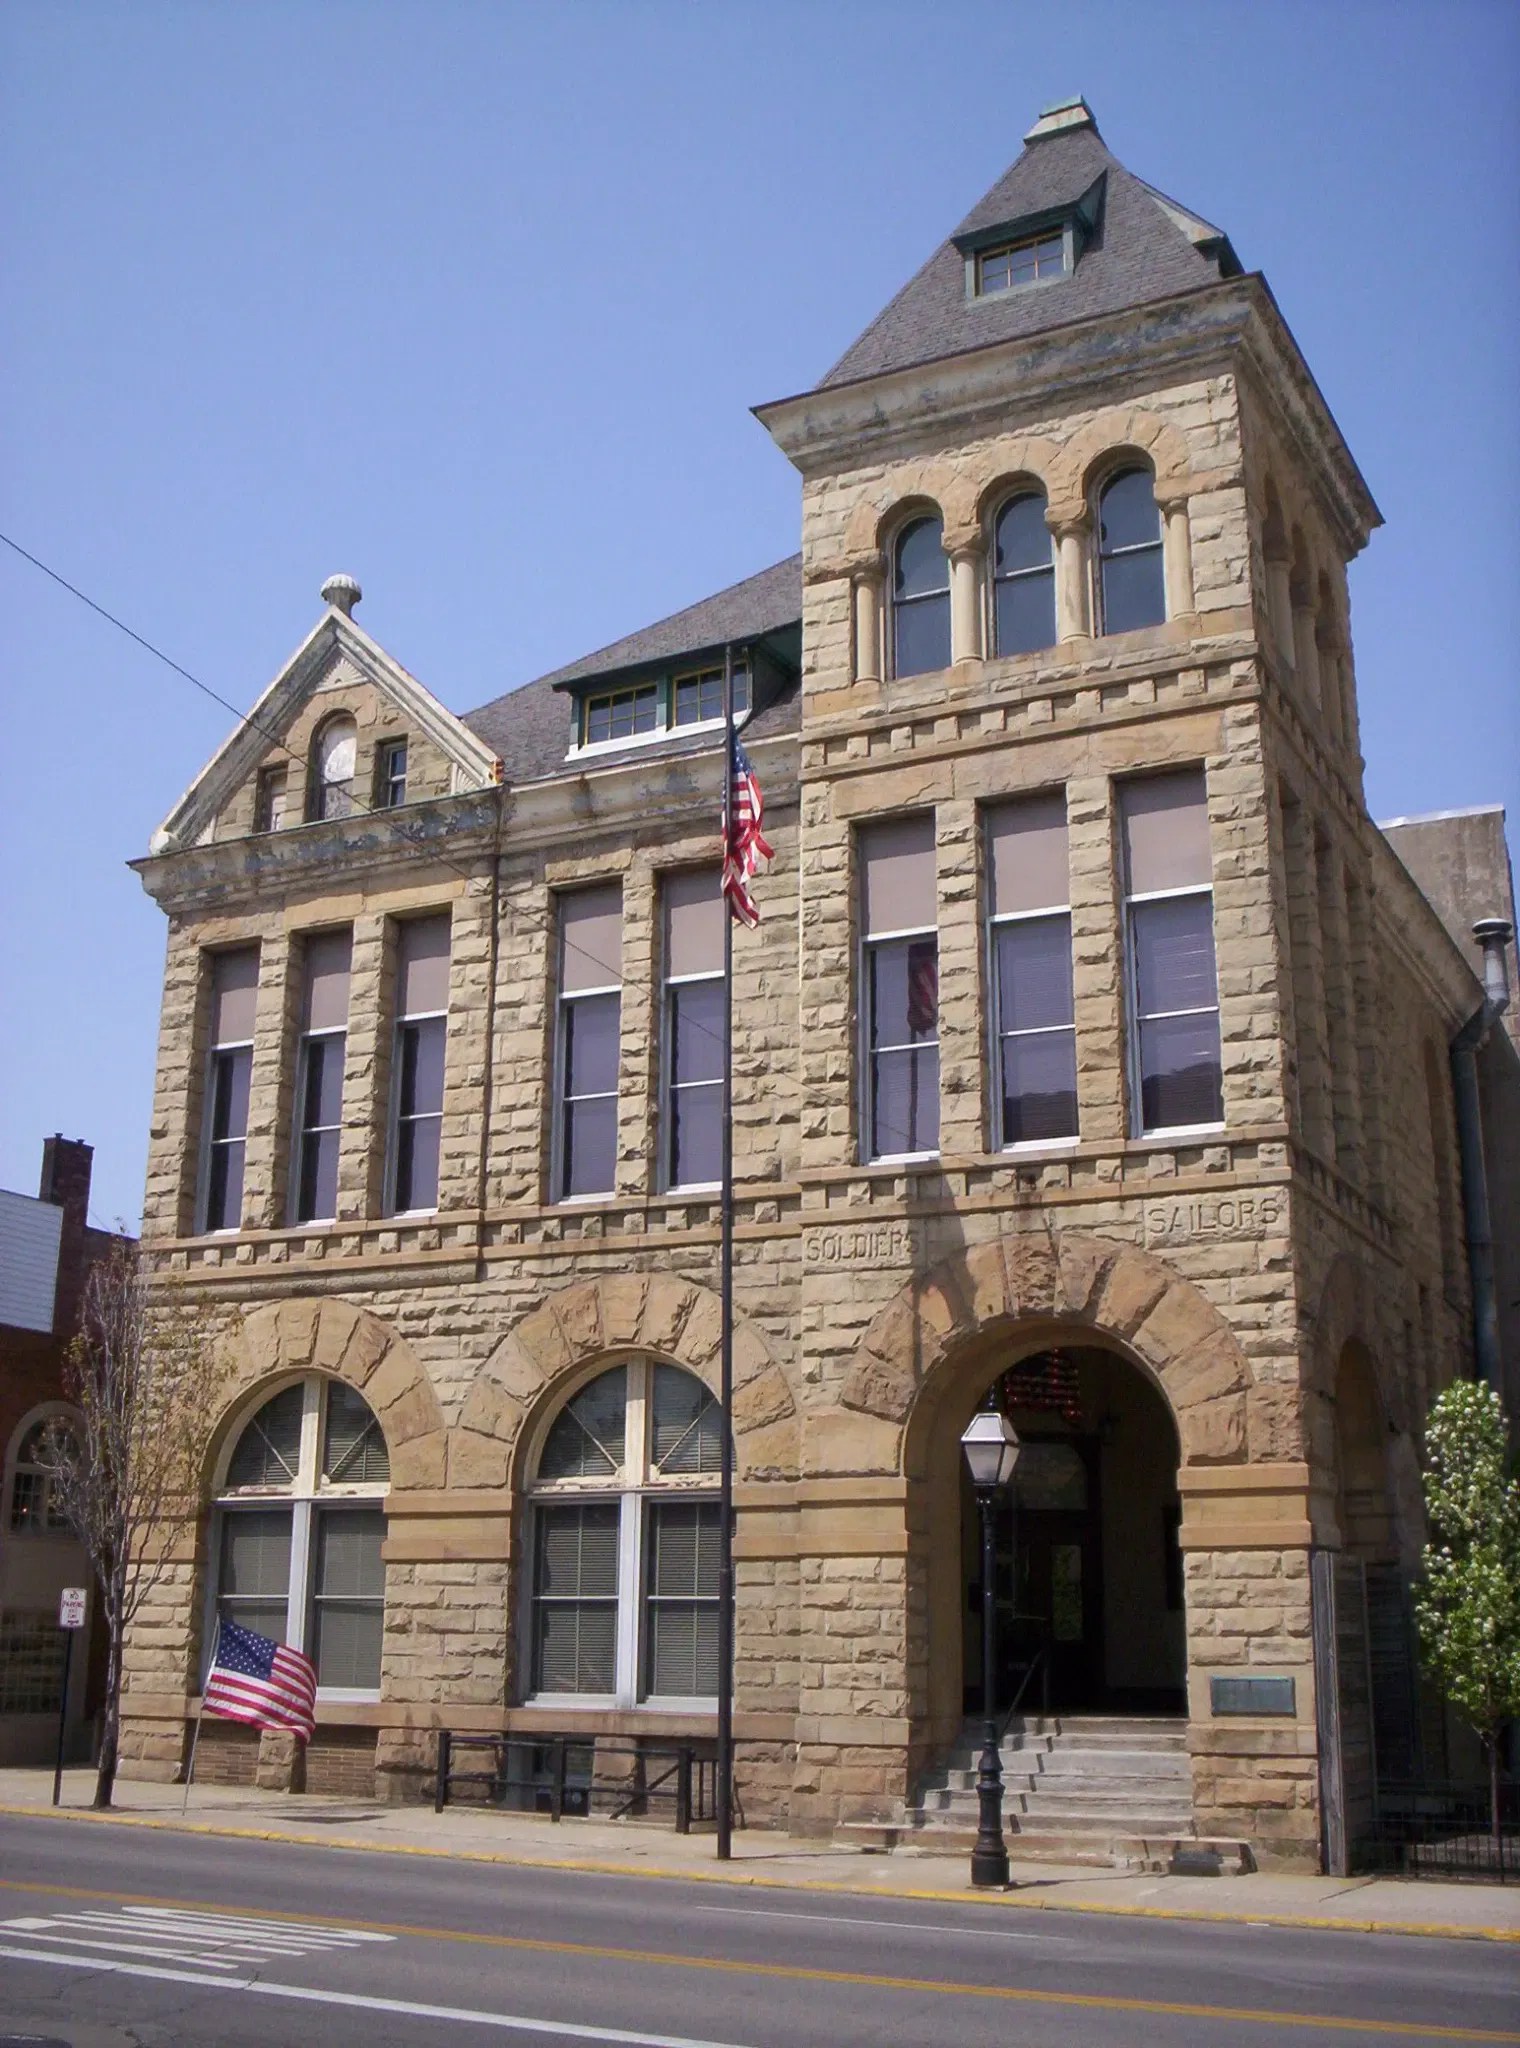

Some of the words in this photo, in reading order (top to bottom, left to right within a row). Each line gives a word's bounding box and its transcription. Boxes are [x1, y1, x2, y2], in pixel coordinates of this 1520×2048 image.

[1149, 1198, 1280, 1235] SAILORS
[806, 1231, 921, 1263] SOLDIERS
[0, 1906, 398, 1970] ONLY
